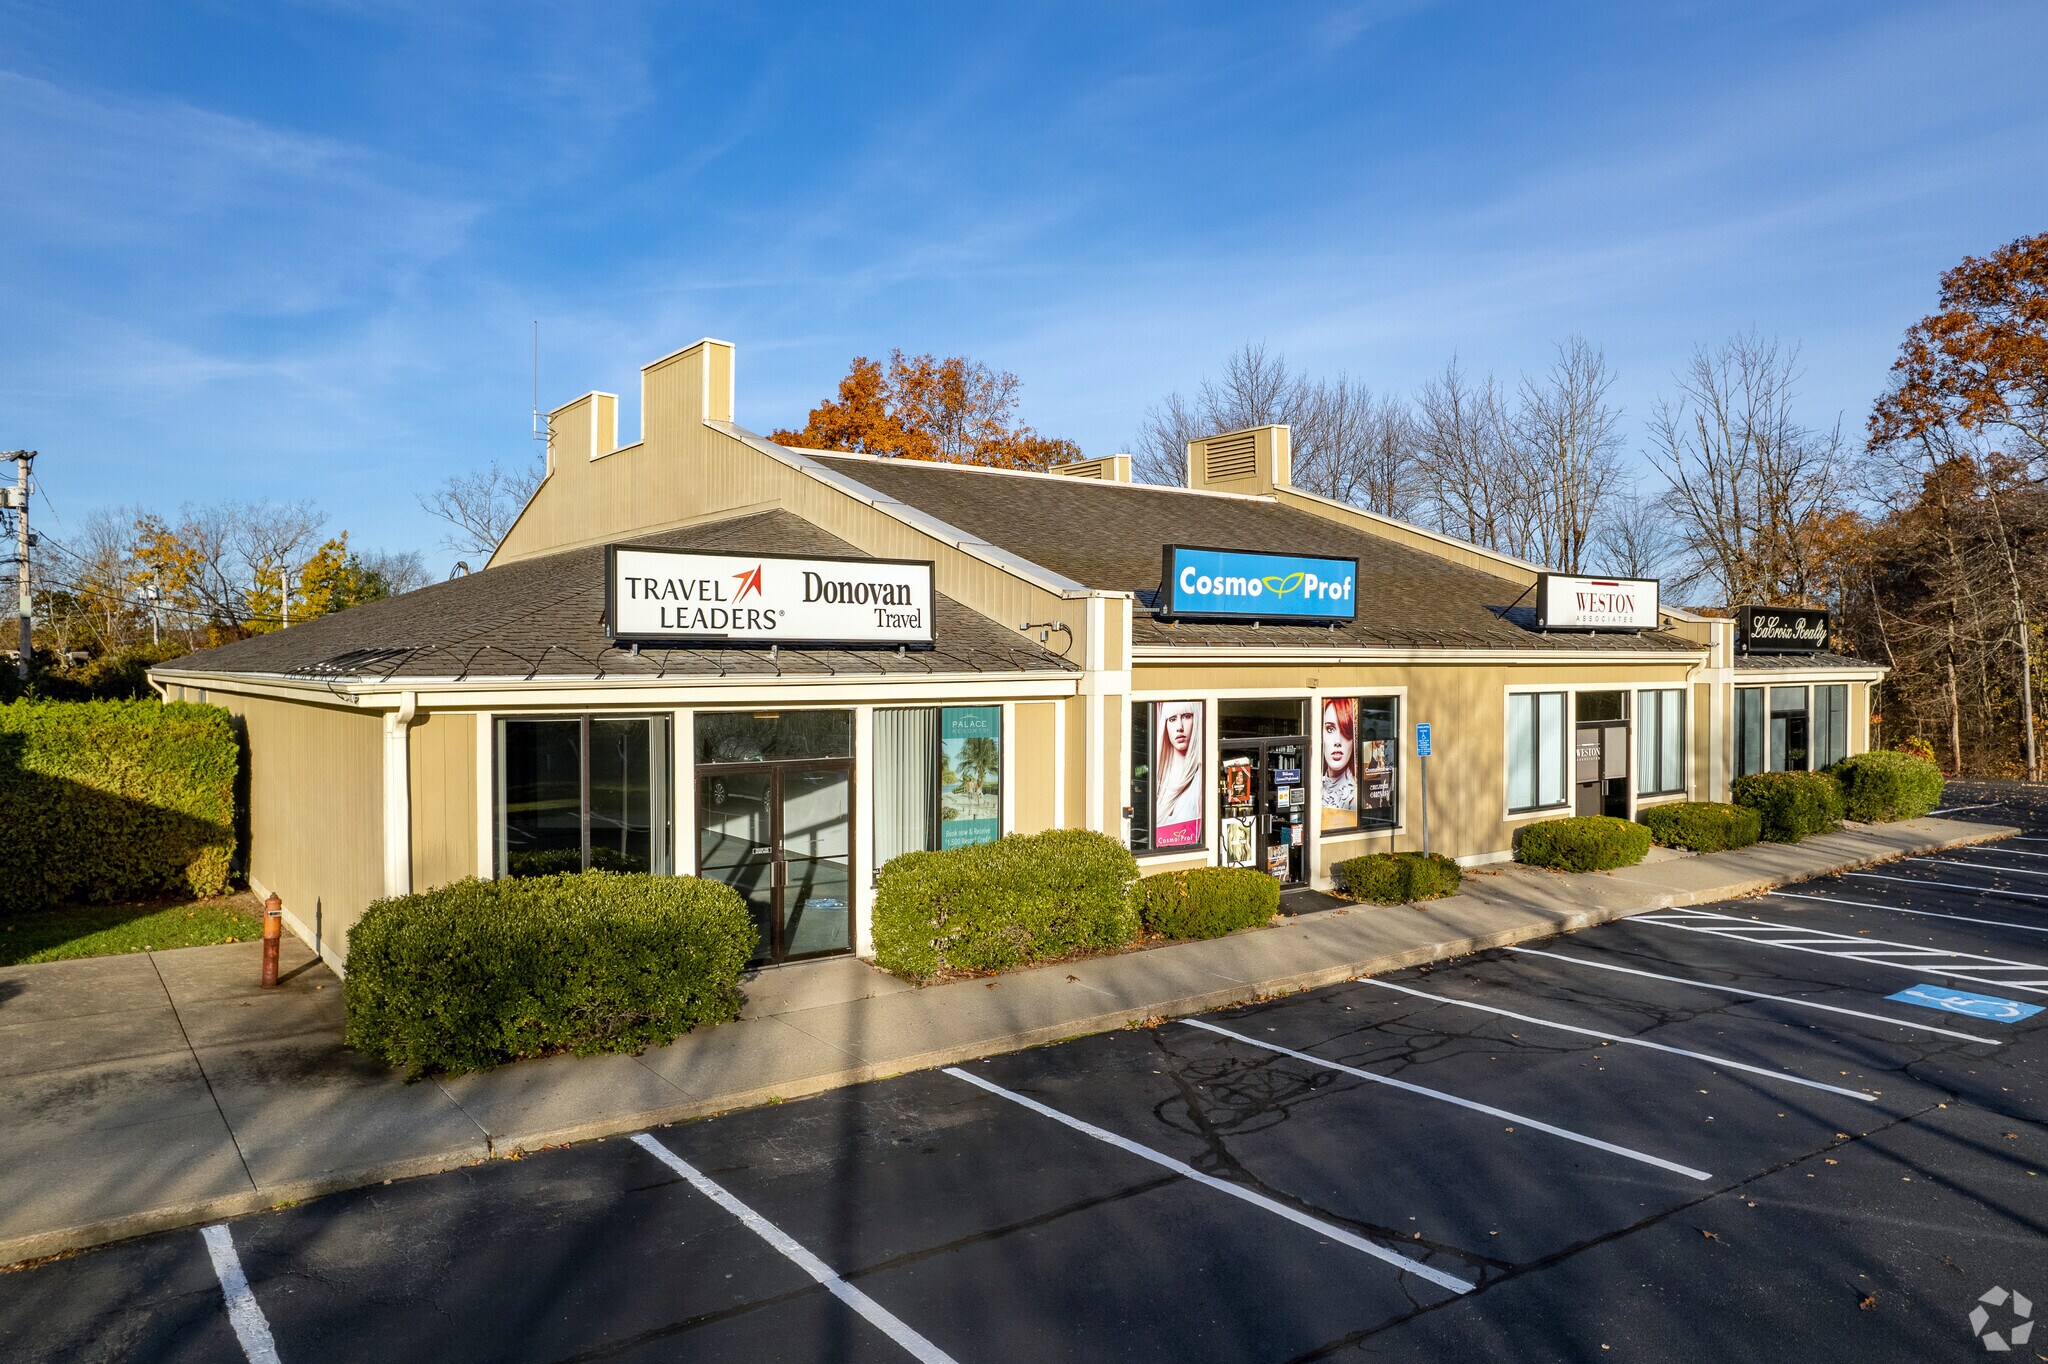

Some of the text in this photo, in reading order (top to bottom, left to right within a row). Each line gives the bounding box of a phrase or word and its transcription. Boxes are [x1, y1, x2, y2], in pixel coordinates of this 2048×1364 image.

[625, 577, 728, 602] TRAVEL
[802, 571, 912, 606] Donovan
[1179, 566, 1352, 600] Cosmo Prof
[1575, 591, 1635, 614] WESTON
[873, 608, 922, 629] Travel
[1575, 615, 1634, 623] ASSOCIATES
[1750, 615, 1828, 647] LaCroix Realty
[952, 720, 987, 728] PALACE
[1576, 747, 1601, 757] WESTON
[1180, 833, 1194, 842] Prof
